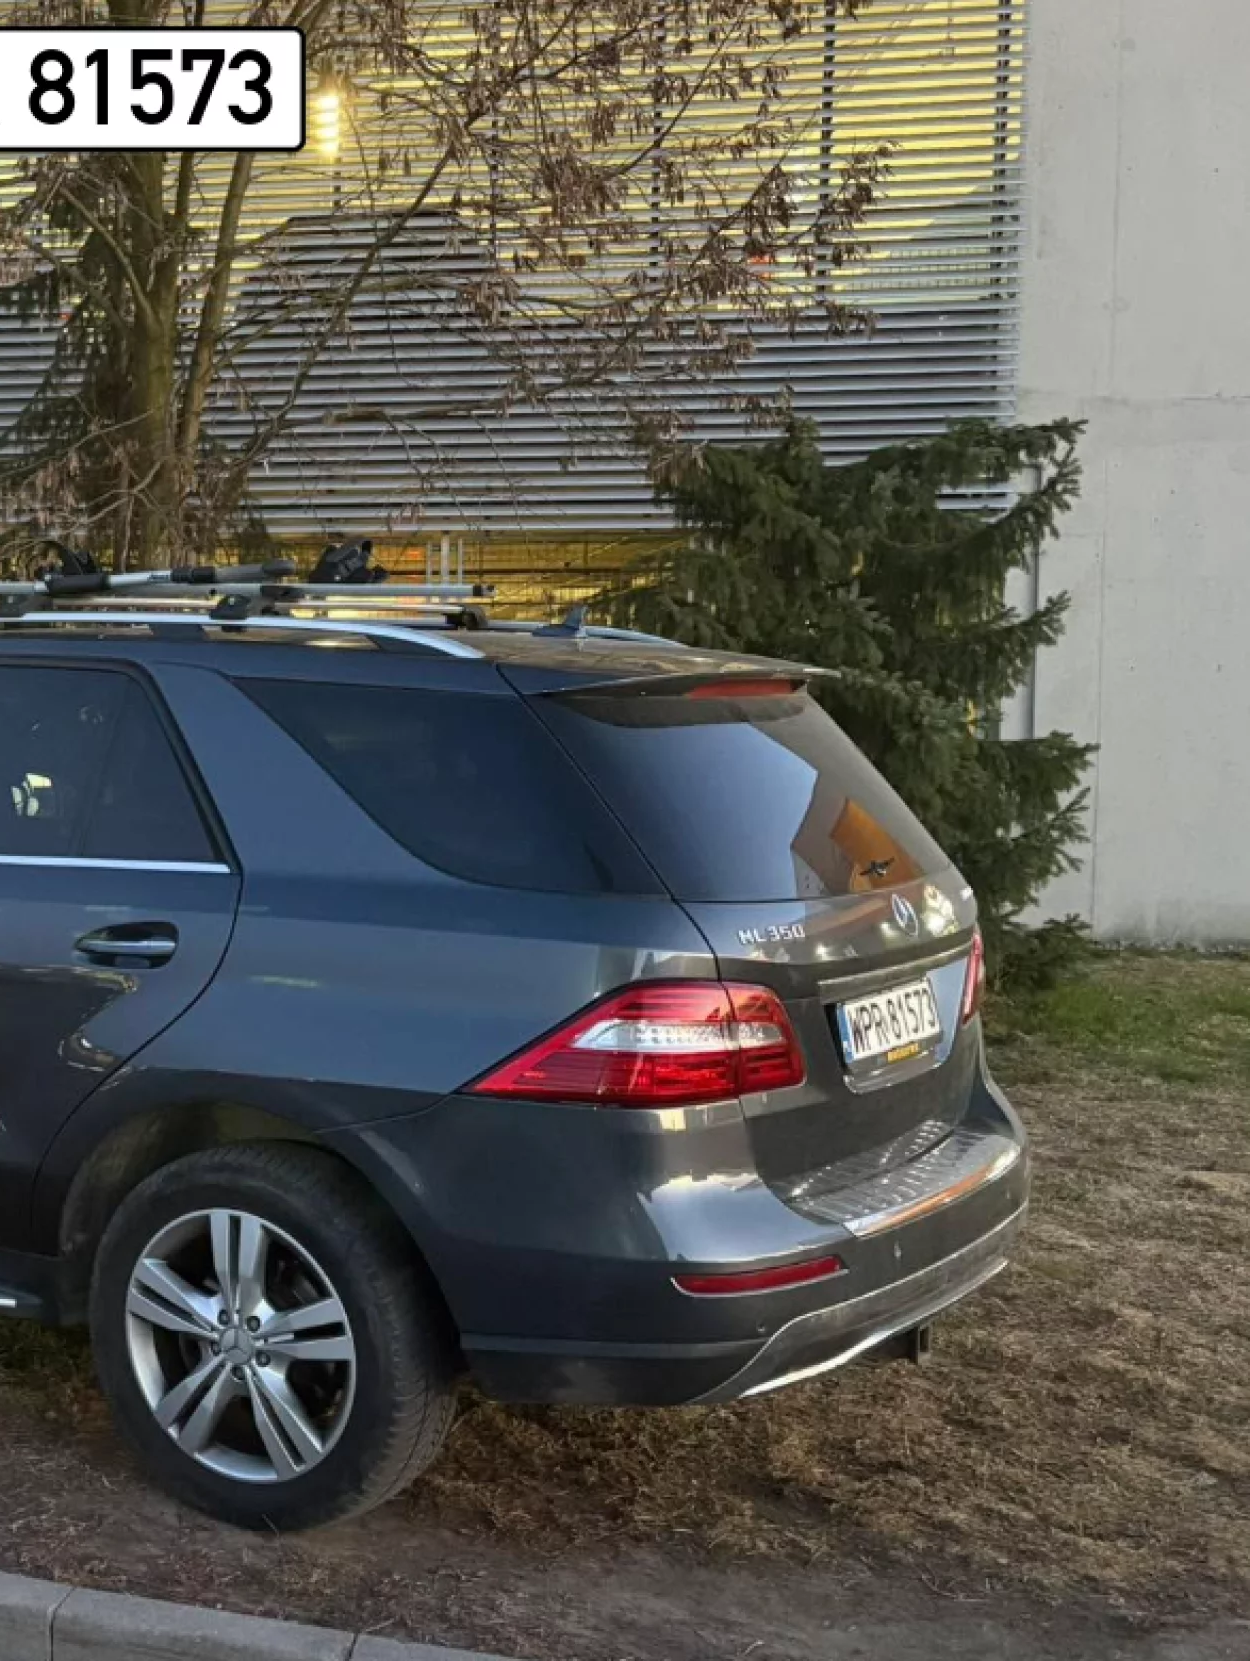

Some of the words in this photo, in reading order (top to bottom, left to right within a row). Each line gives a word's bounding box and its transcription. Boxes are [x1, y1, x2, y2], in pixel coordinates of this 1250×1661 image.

[738, 928, 765, 946] ML
[768, 924, 805, 942] 350
[847, 1003, 890, 1053] WPR
[887, 987, 937, 1040] 81573
